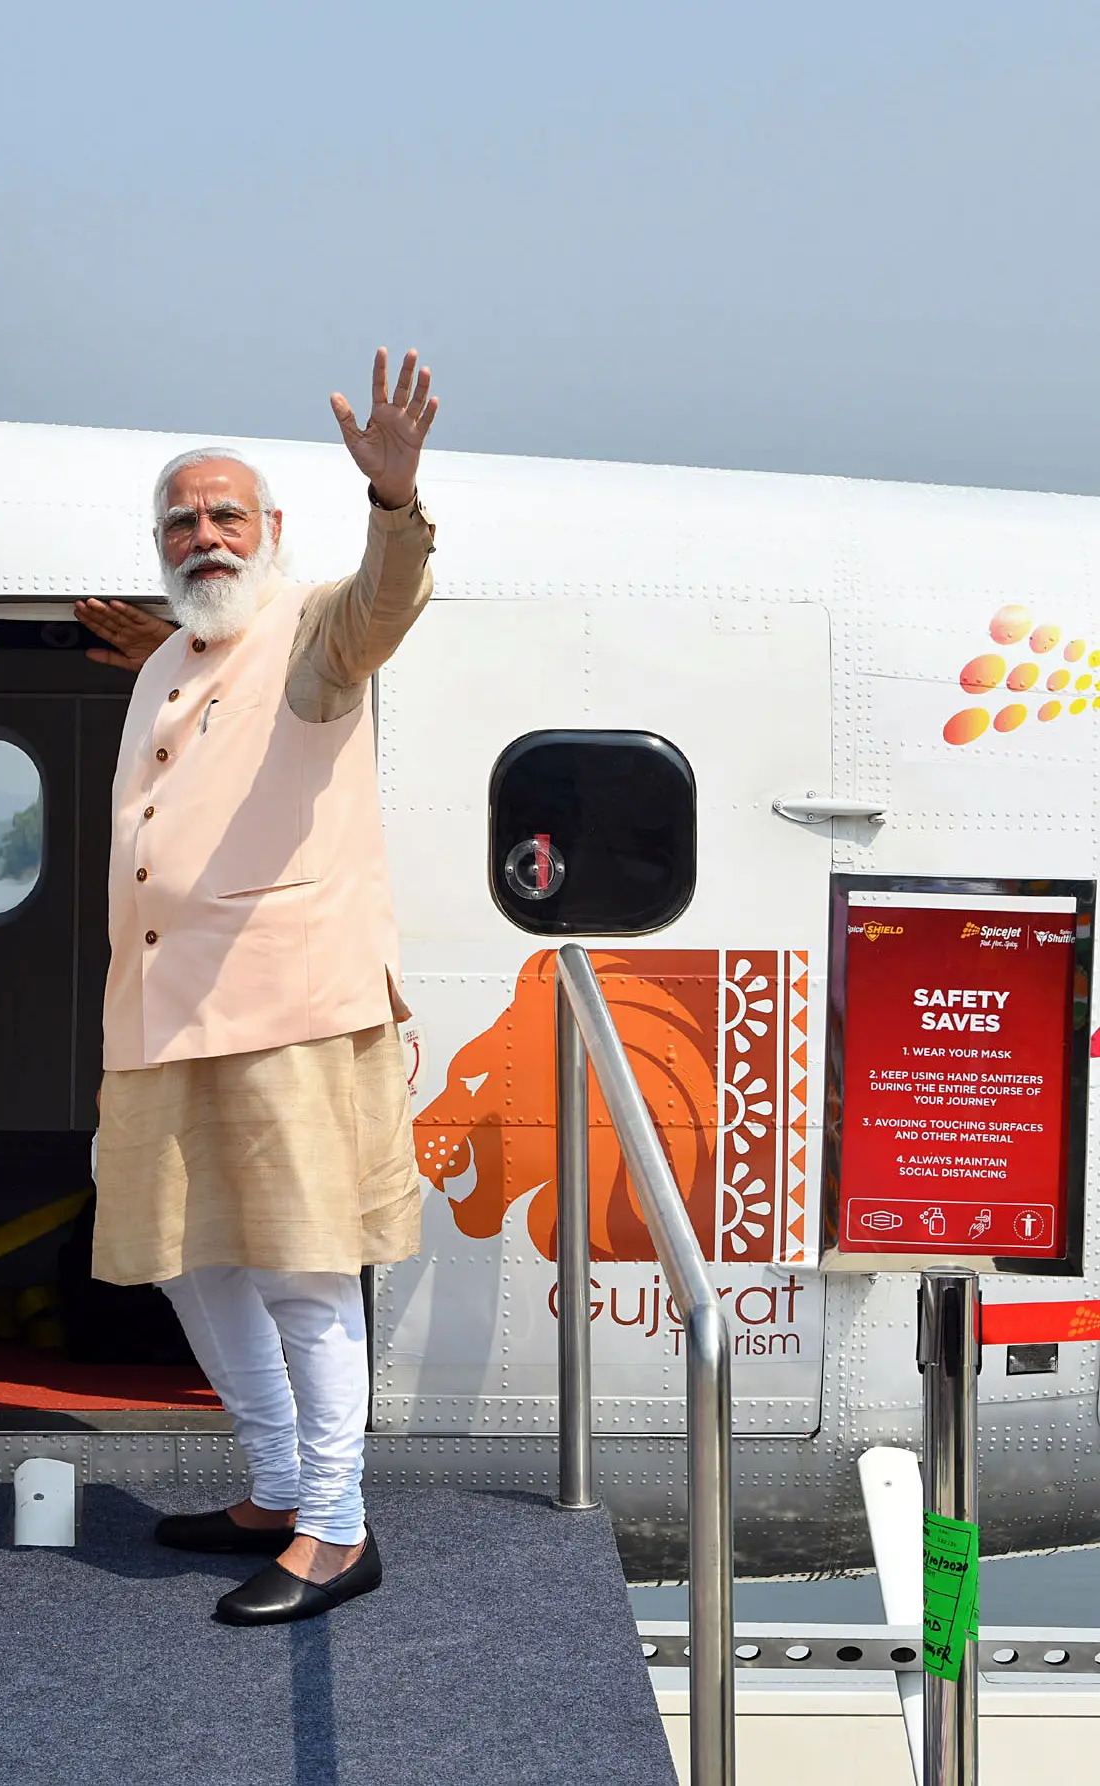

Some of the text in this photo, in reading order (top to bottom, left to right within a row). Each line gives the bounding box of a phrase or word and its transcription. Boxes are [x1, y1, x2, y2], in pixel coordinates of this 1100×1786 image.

[867, 925, 904, 934] SHIELD
[980, 925, 1021, 939] SpiceJet
[913, 988, 1010, 1009] SAFETY
[921, 1012, 1001, 1032] SAVES
[902, 1047, 1012, 1059] 1. WEAR YOUR MASK
[869, 1070, 1043, 1084] 2. KEEP USING HAND SANITIZERS
[870, 1082, 1041, 1096] DURING THE ENTIRE COURSE OF
[913, 1095, 997, 1106] YOUR JOURNEY
[862, 1118, 1043, 1132] 3. AVOIDING TOUCHING SURFACES
[895, 1131, 1014, 1143] AND OTHER MATERIAL
[896, 1155, 1007, 1167] 4. ALWAYS MAINTAIN
[899, 1167, 1007, 1178] SOCIAL DISTANCING
[669, 1328, 800, 1356] Trism
